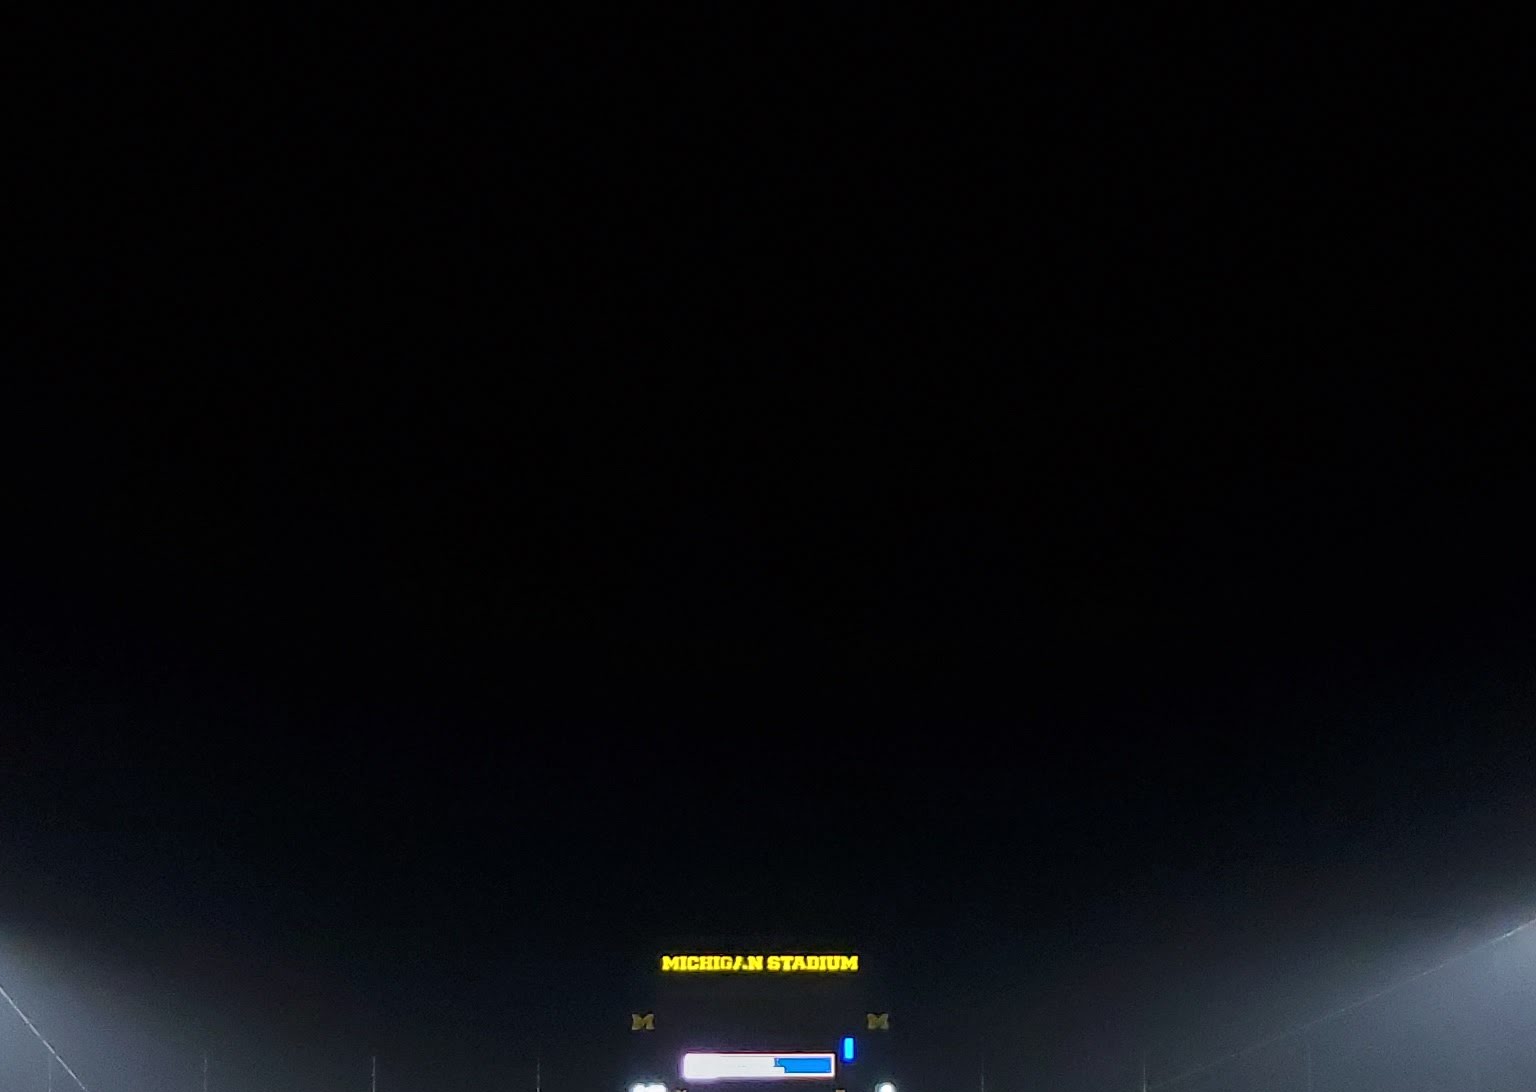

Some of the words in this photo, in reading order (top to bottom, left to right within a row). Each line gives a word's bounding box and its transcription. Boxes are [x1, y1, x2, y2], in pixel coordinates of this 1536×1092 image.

[661, 955, 763, 972] MICHIGAN
[767, 955, 859, 972] STADIUM
[631, 1012, 655, 1031] M
